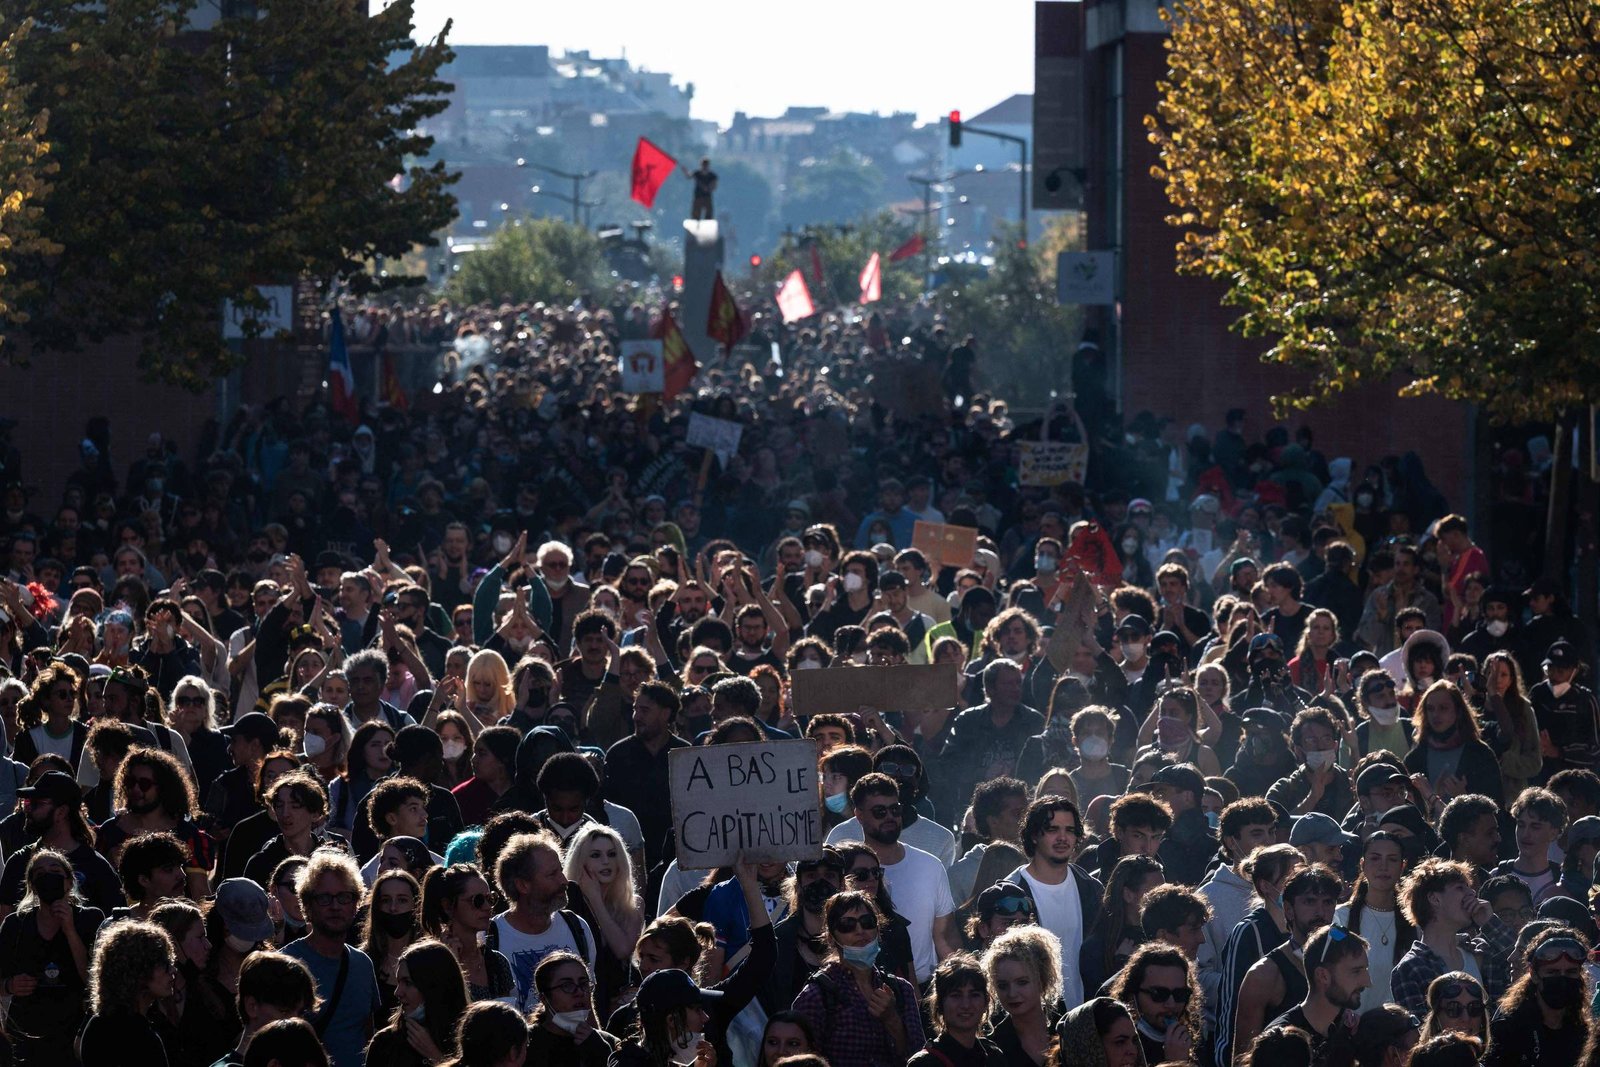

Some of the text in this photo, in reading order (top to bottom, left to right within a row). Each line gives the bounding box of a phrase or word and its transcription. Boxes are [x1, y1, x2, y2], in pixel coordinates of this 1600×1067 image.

[687, 752, 808, 793] A BAS LE
